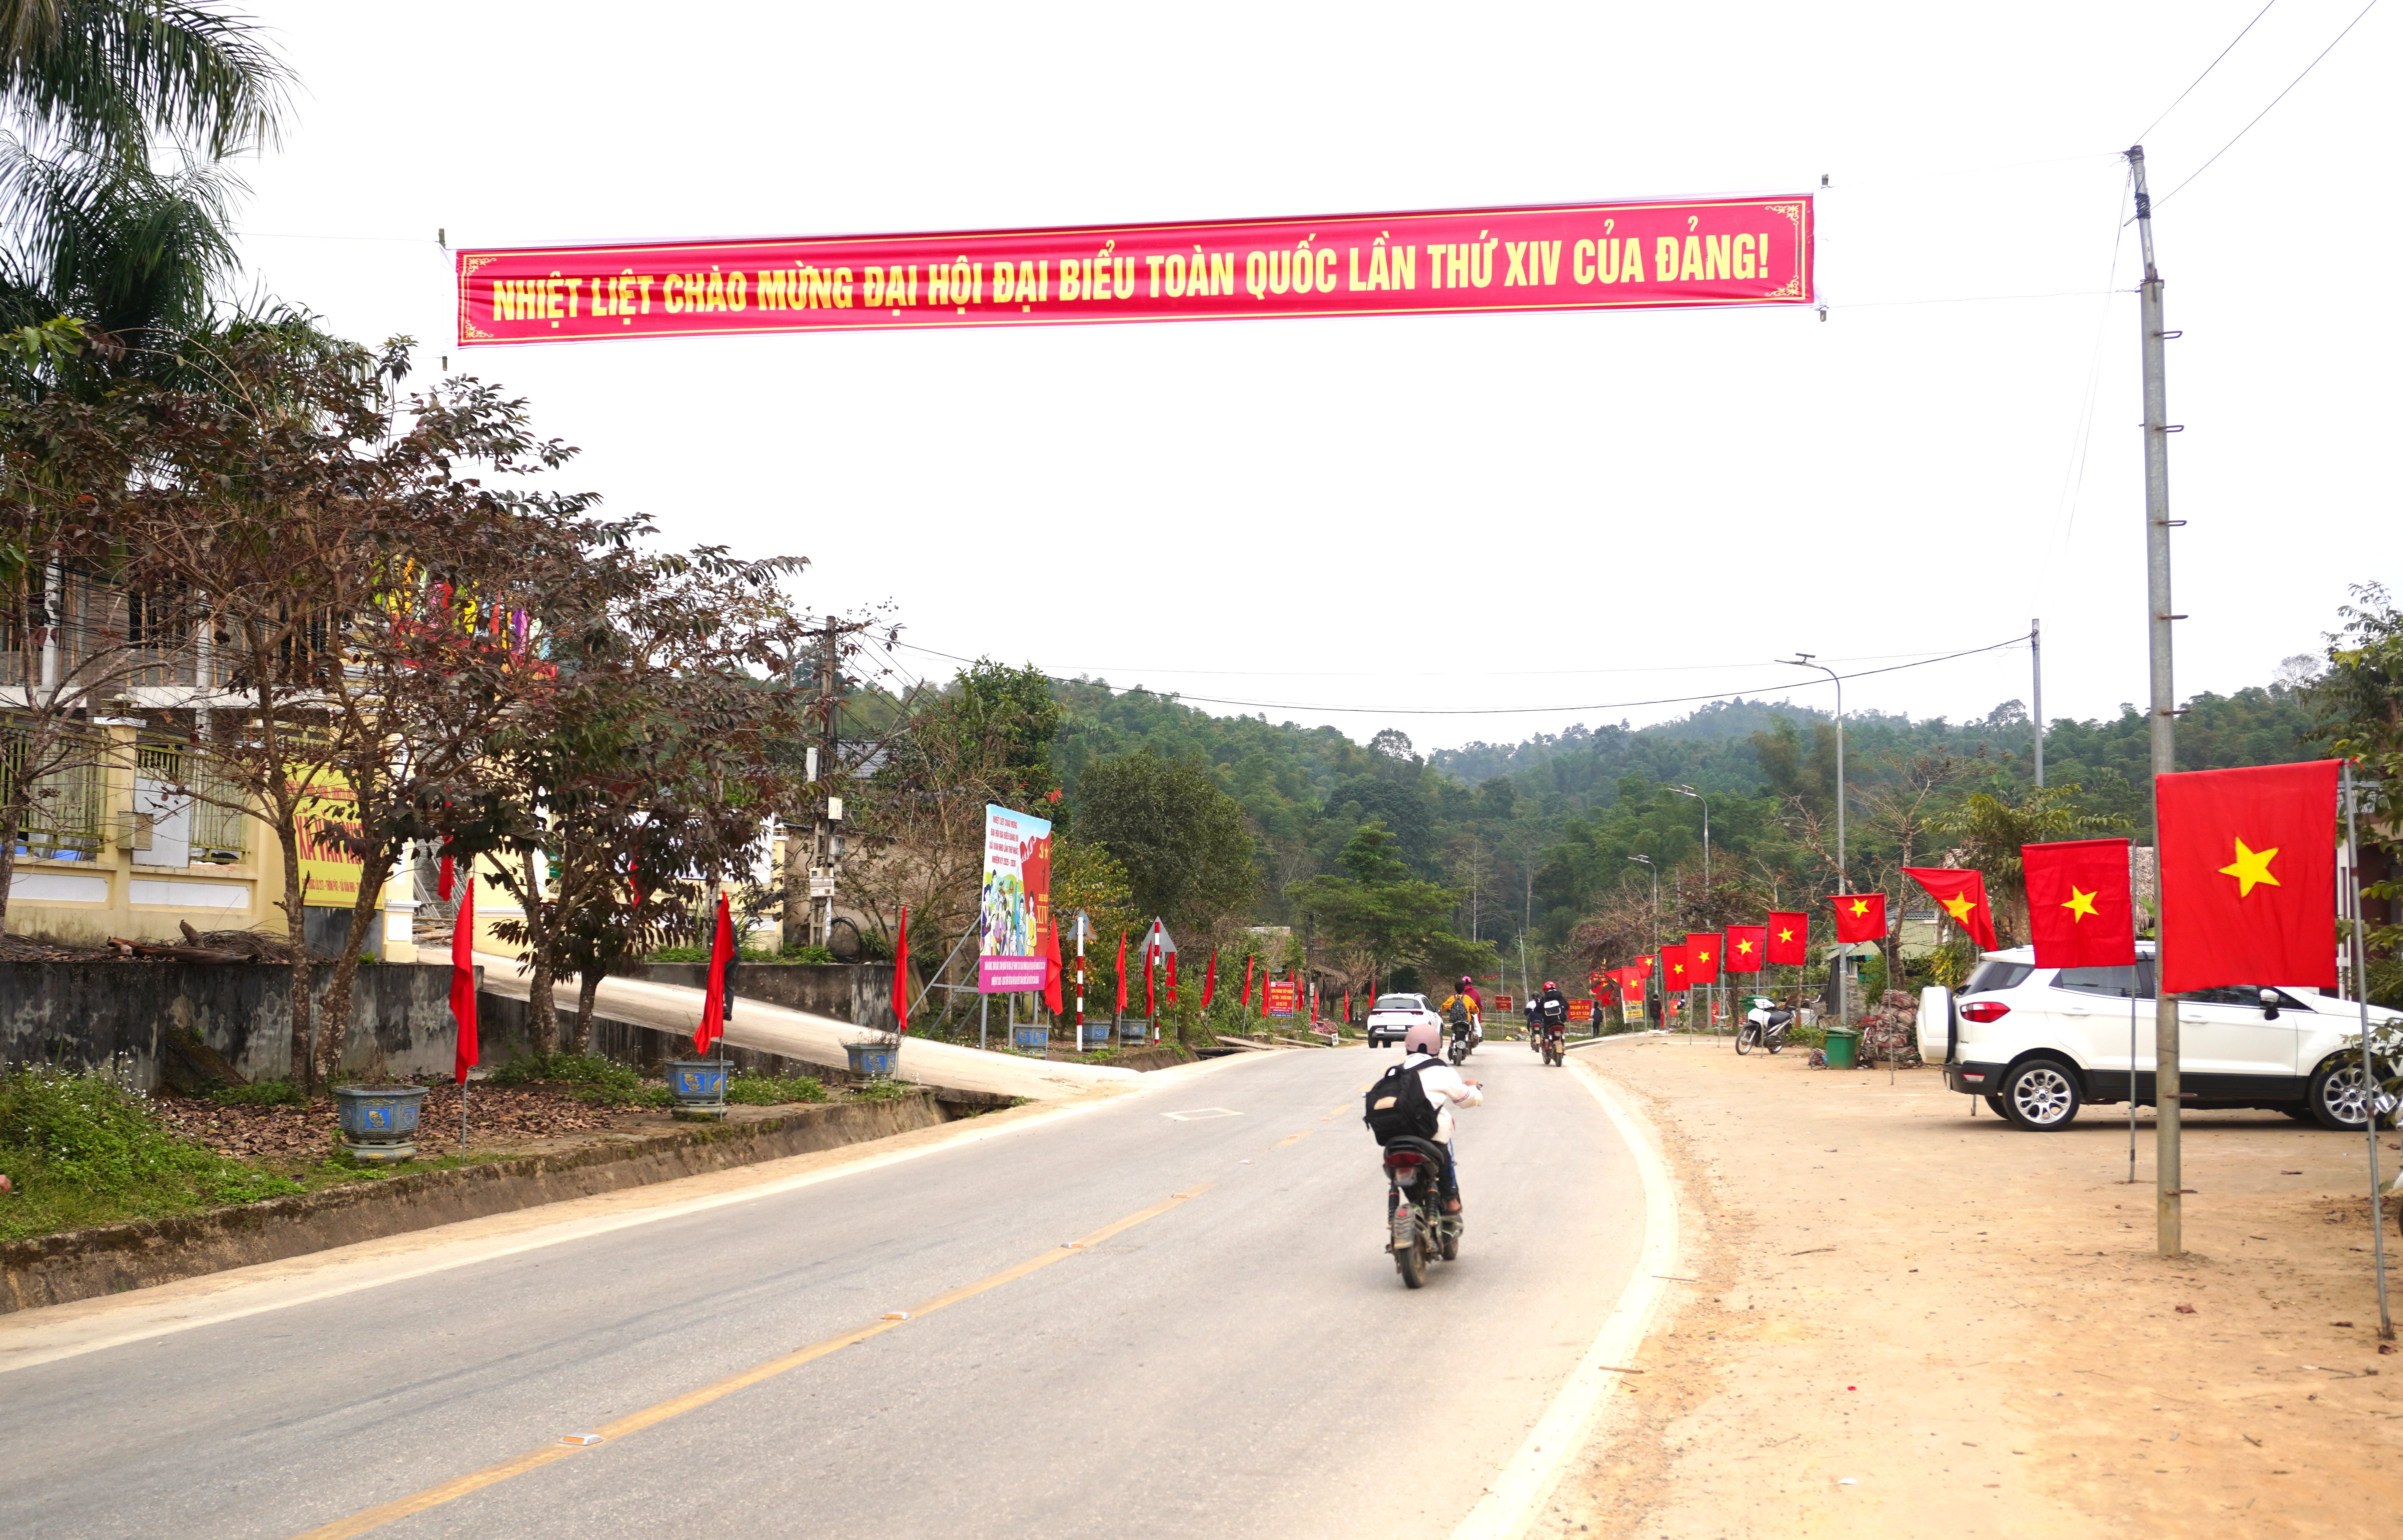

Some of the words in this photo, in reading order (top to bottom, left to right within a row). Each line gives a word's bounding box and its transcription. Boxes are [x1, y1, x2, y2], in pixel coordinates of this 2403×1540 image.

[493, 271, 582, 328] NHIỆT
[591, 269, 654, 324] LIỆT
[663, 265, 747, 313] CHÀO
[757, 260, 853, 310] MỪNG
[863, 265, 917, 315] ĐẠI
[928, 255, 982, 314] HỘI
[993, 260, 1048, 312] ĐẠI
[1059, 240, 1135, 301] BIỂU
[1146, 245, 1234, 297] TOÀN
[1246, 233, 1336, 299] QUỐC
[1350, 230, 1415, 291] LẦN
[1428, 230, 1498, 288] THỨ
[1505, 240, 1562, 286] XIV
[1574, 219, 1644, 284] CỦA
[1655, 216, 1768, 281] ĐẢNG!
[1036, 905, 1048, 924] XIV
